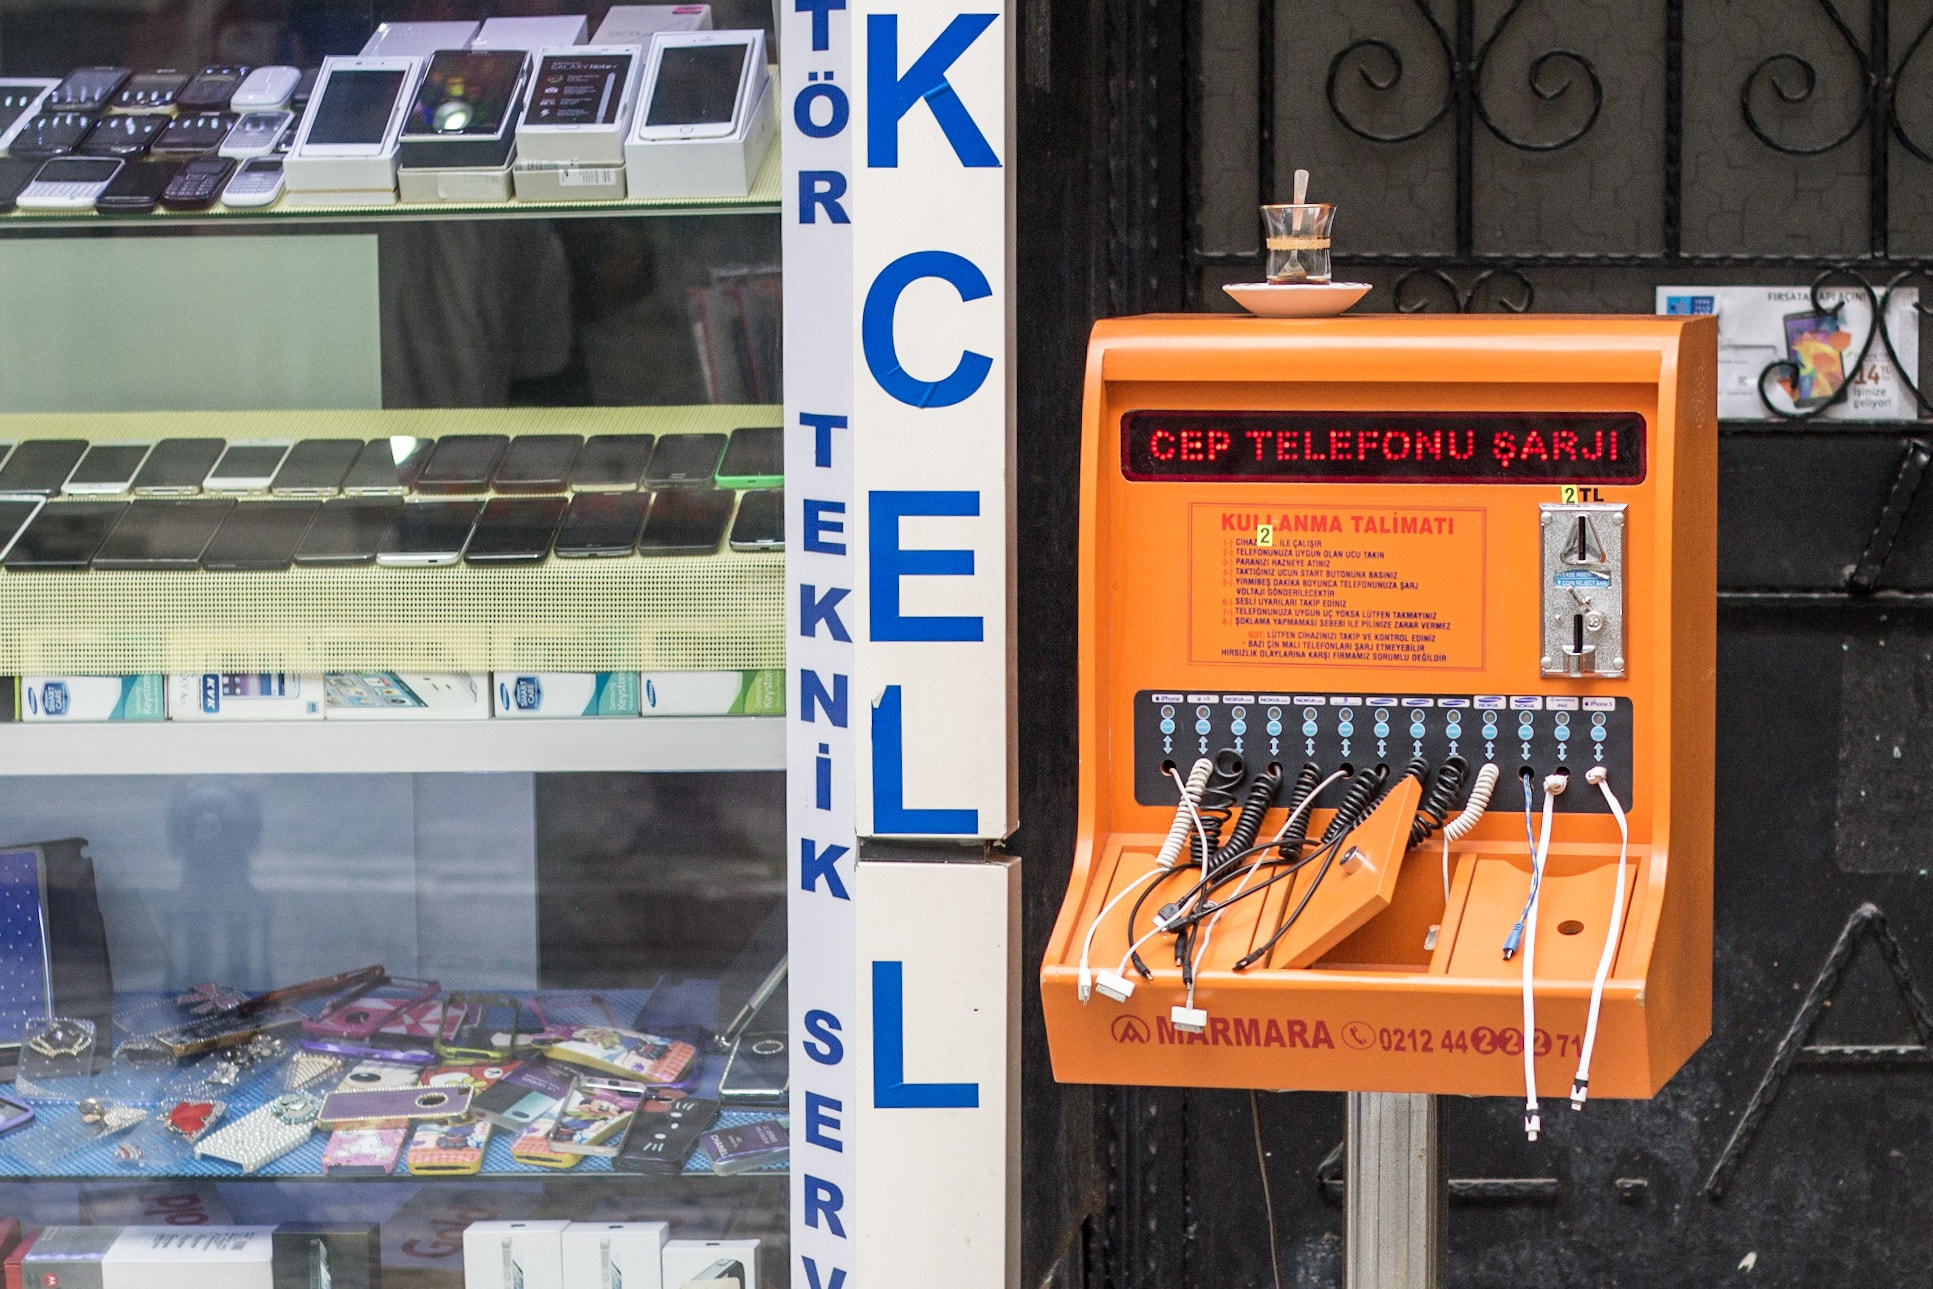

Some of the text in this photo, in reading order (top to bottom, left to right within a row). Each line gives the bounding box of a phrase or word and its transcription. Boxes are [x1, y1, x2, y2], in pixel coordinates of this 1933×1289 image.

[1149, 430, 1618, 467] CEP TELEFONU ŞARJI
[1564, 487, 1604, 503] 2 TL
[1351, 511, 1454, 535] TALİMATI
[1236, 548, 1292, 557] TELEFONUNUZA
[1296, 549, 1321, 558] UYGUN
[1324, 550, 1343, 558] OLAN
[1364, 551, 1385, 559] TAKIN
[1236, 558, 1269, 566] PARANIZI
[1272, 559, 1304, 567] HAZNEYE
[1307, 559, 1331, 567] ATINIZ
[1301, 569, 1323, 577] START
[1326, 570, 1366, 578] BUTONUNA
[1369, 571, 1398, 579] BASINIZ
[1303, 579, 1337, 588] BOYUNCA
[1340, 580, 1397, 589] TELEFONUNUZA
[1400, 582, 1419, 591] ŞARJ
[1235, 607, 1292, 616] TELEFONUNUZA
[1295, 608, 1320, 617] UYGUN
[1336, 610, 1360, 618] YOKSA
[1362, 609, 1390, 618] LÜTFEN
[1393, 611, 1437, 620] TAKMAYINIZ
[1235, 617, 1271, 626] ŞOKLAMA
[1273, 618, 1317, 627] YAPMAMASI
[1394, 621, 1419, 629] ZARAR
[1421, 622, 1451, 630] VERMEZ
[1267, 630, 1295, 638] LÜTFEN
[1374, 633, 1409, 642] KONTROL
[1248, 640, 1264, 648] BAZI
[1303, 641, 1352, 650] TELEFONLARI
[1355, 643, 1373, 652] ŞARJ
[799, 412, 852, 900] TEKNİK
[1221, 649, 1258, 657] HIRSIZLIK
[1260, 650, 1306, 658] OLAYLARINA
[1308, 651, 1331, 660] KARŞI
[1372, 652, 1410, 661] SORUMLU
[206, 677, 215, 709] KVK
[1379, 1028, 1434, 1053] 0212
